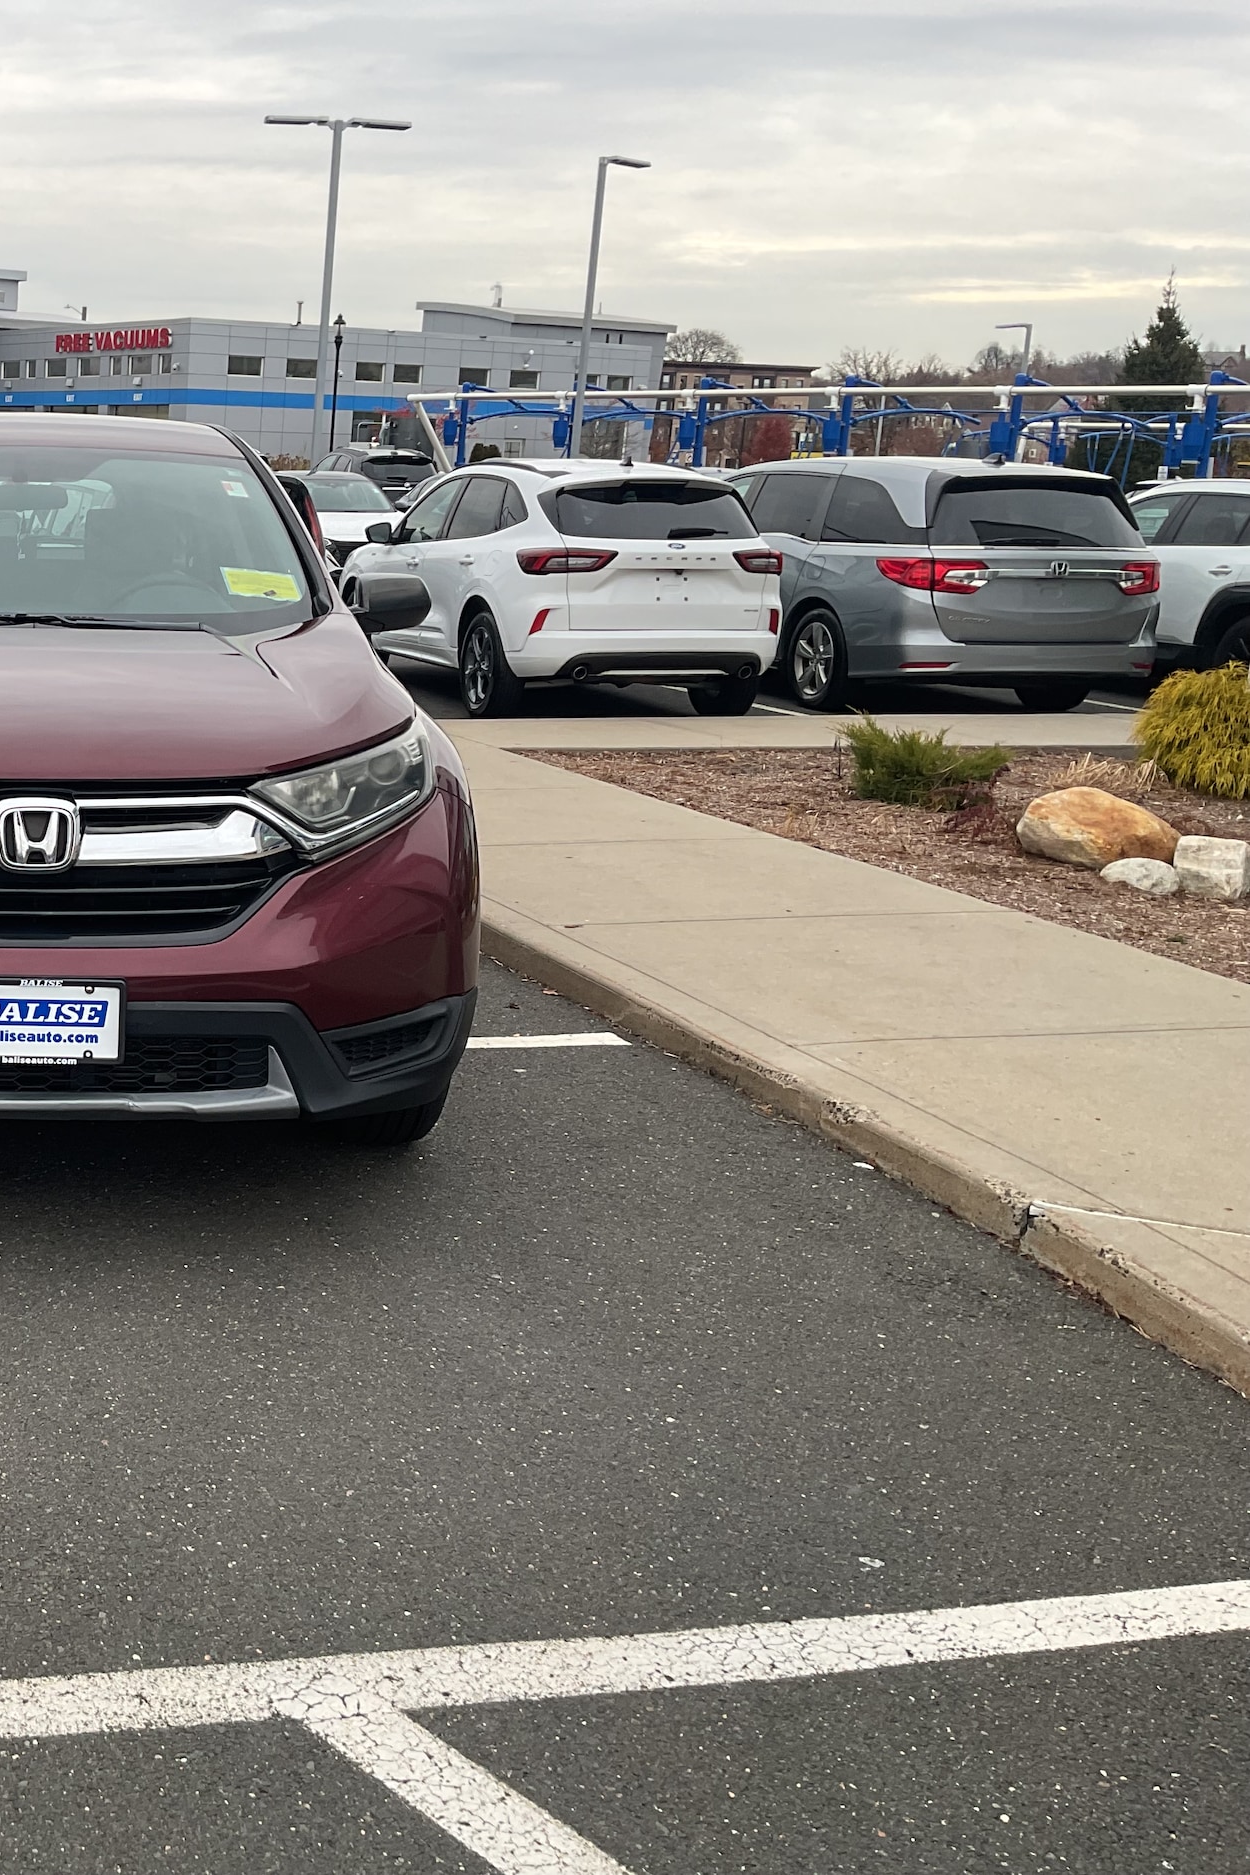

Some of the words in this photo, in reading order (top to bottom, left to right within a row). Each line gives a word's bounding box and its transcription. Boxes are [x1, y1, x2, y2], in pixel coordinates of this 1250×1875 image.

[55, 333, 94, 353] FREE
[95, 327, 173, 350] VACUUMS
[19, 979, 63, 987] BALISE
[1, 1056, 78, 1066] baliseauto.com
